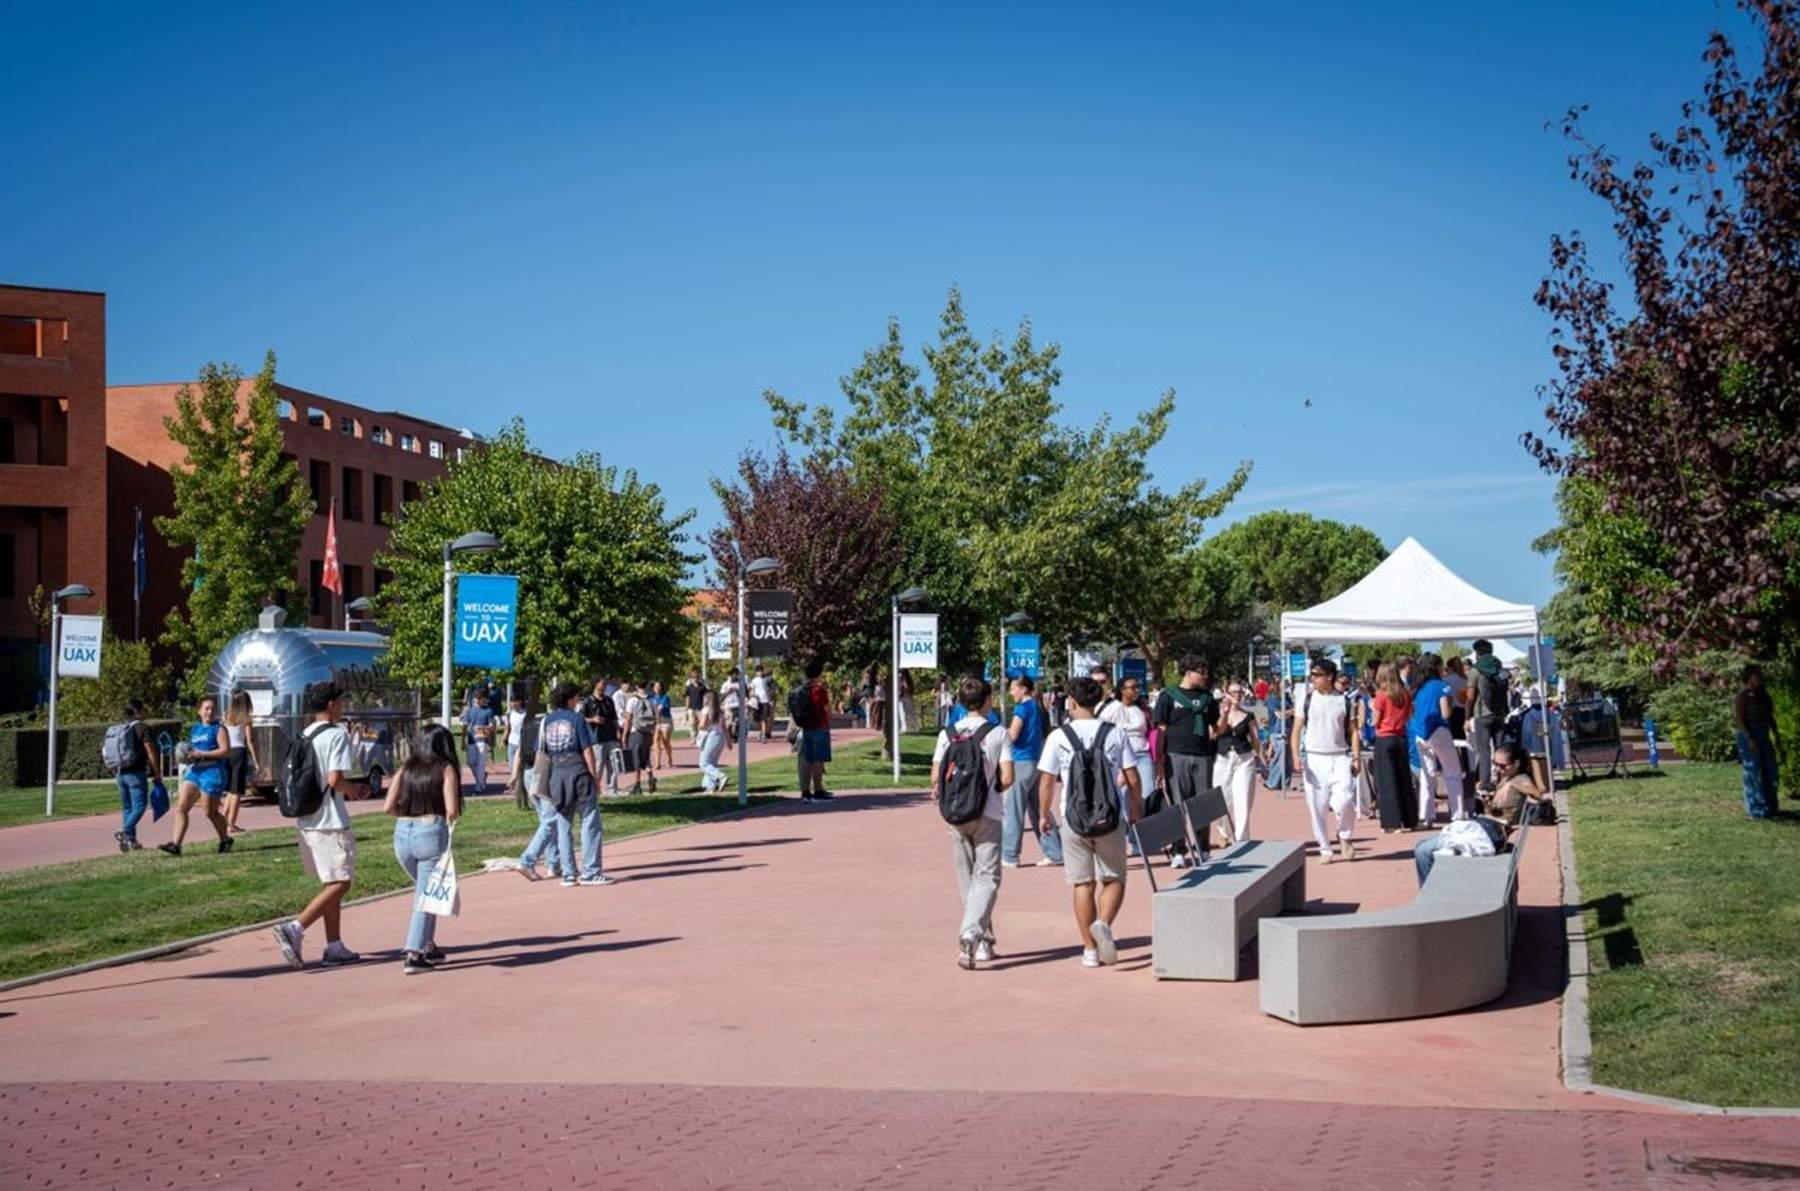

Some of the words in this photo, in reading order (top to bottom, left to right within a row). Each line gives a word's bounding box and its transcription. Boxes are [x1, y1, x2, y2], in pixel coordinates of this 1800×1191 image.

[463, 602, 510, 613] WELCOME
[481, 614, 491, 622] TO
[753, 610, 788, 618] WELCOME
[462, 621, 508, 643] UAX
[752, 624, 788, 640] UAX
[904, 641, 933, 654] UAX
[64, 647, 96, 663] UAX
[1010, 657, 1035, 668] UAX
